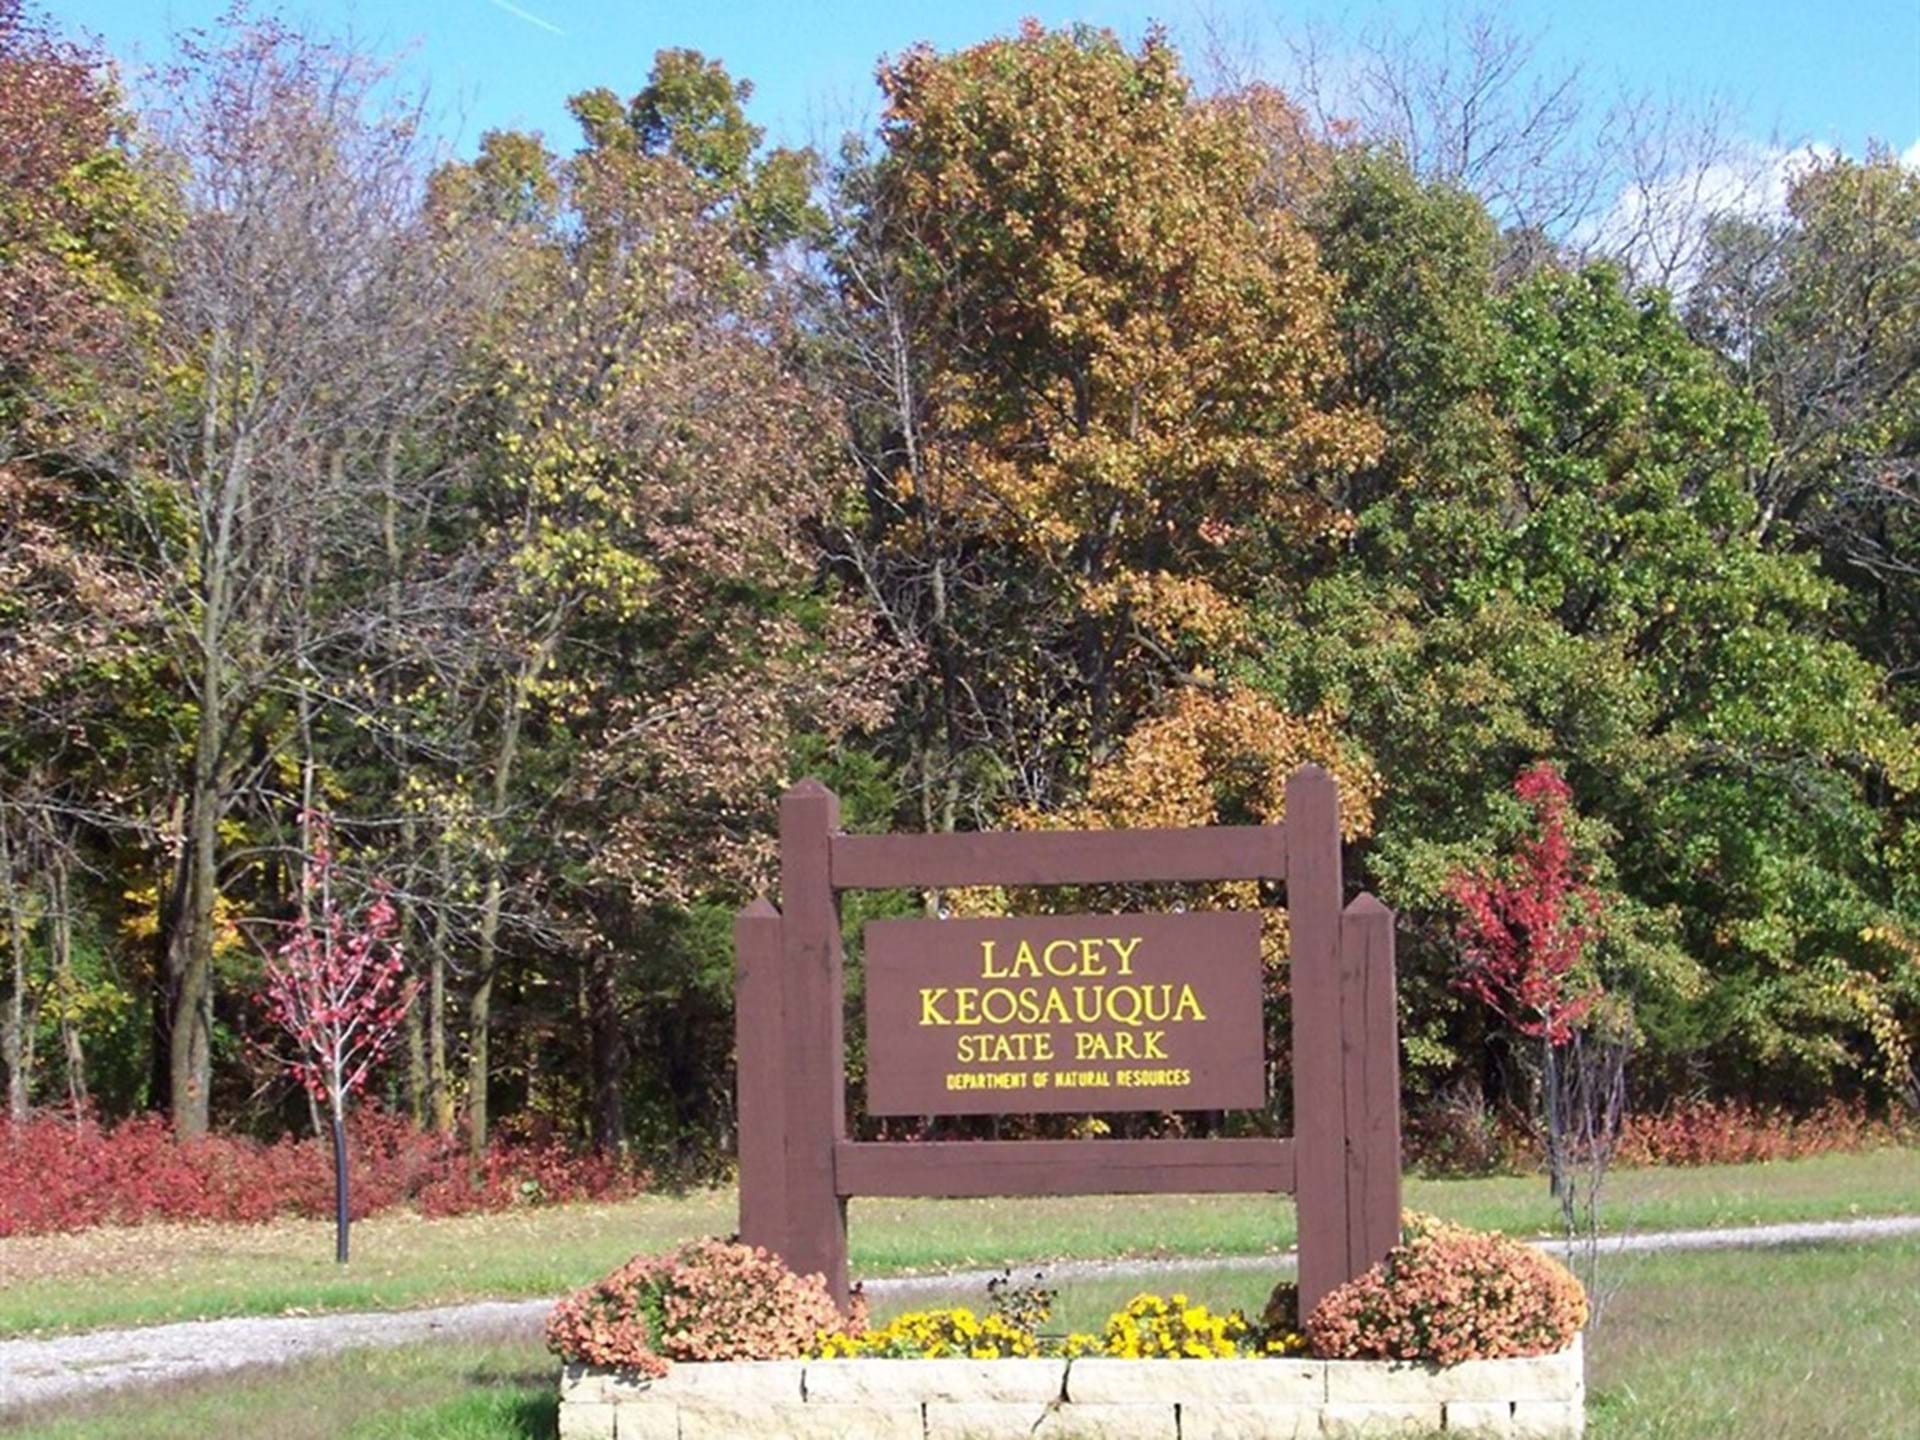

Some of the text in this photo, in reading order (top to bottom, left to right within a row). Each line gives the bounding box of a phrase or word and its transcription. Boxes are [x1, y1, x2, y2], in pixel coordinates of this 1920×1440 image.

[981, 937, 1142, 978] LACEY
[919, 984, 1206, 1026] KEOSAUQUA
[957, 1031, 1168, 1062] STATE PARK
[946, 1068, 1191, 1090] DEPARTMENT OF NATURAL RESOURCES
